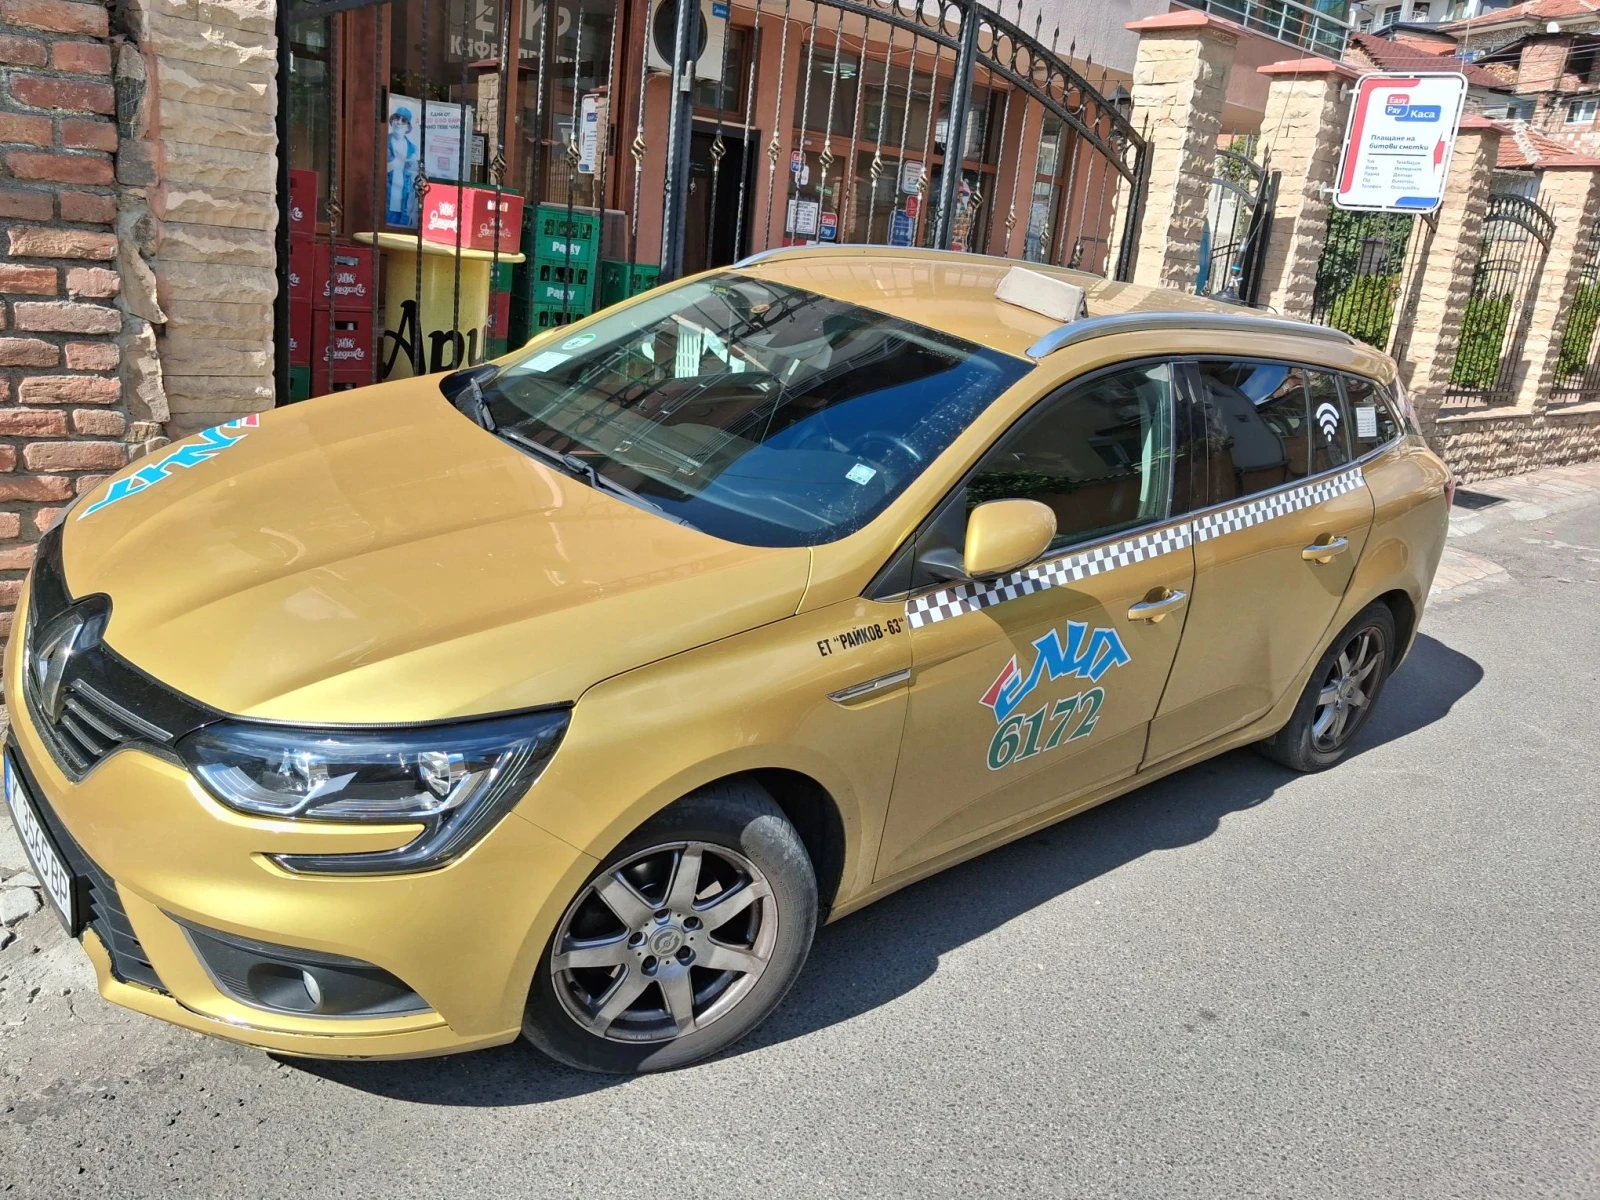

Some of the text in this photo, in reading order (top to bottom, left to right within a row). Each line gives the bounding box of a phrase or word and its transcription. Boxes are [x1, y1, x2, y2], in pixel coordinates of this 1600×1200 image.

[1388, 96, 1407, 105] Easy
[1386, 105, 1402, 115] Pay
[1410, 109, 1436, 119] Каса
[1370, 134, 1406, 142] Плащане
[1368, 142, 1429, 151] битови сметки
[821, 215, 835, 225] Easy
[820, 227, 832, 237] Pay
[551, 241, 581, 256] Paty
[816, 638, 833, 657] ЕТ
[986, 686, 1105, 771] 6172
